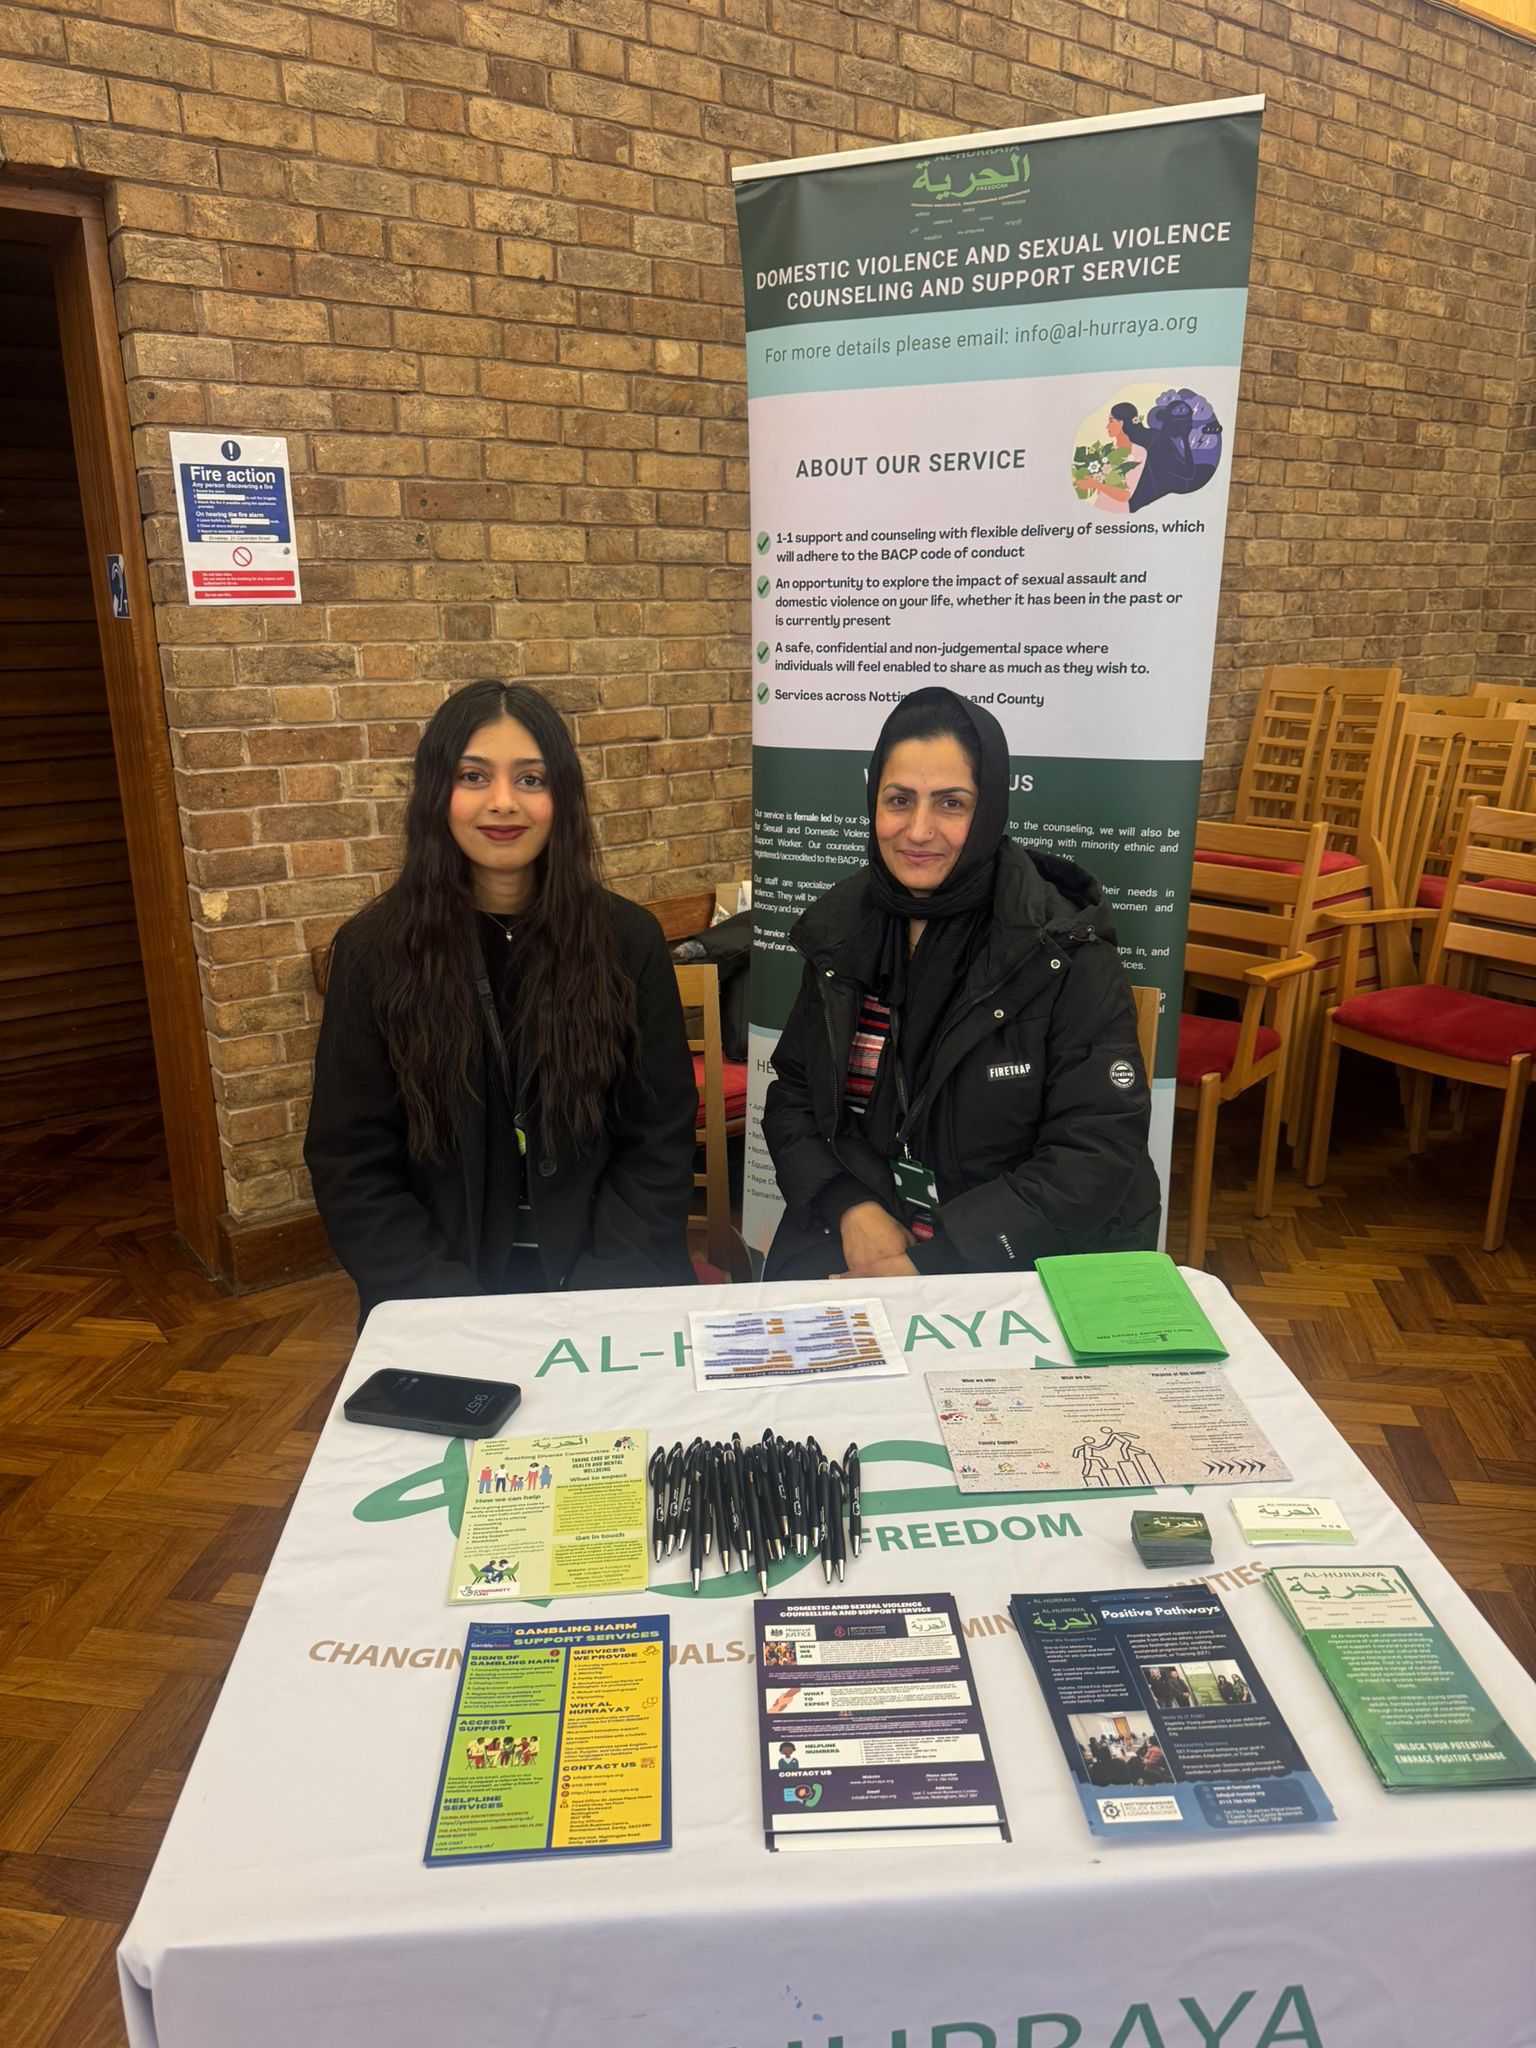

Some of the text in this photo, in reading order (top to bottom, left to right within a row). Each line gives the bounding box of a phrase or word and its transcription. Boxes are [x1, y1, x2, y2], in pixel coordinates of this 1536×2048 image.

[756, 221, 1231, 290] DOMESTIC VIOLENCE AND SEXUAL VIOLENCE
[787, 254, 1181, 310] COUNSELING AND SUPPORT SERVICE
[765, 315, 1198, 364] For more details please email: info@al-hurraya.org
[796, 449, 1026, 478] ABOUT OUR SERVICE
[190, 466, 276, 483] Fire action
[776, 520, 1205, 545] 1-1 support and counseling with flexible delivery of sessions, which
[776, 545, 1025, 562] will adhere to the BACP code of conduct
[776, 571, 1147, 591] An opportunity to explore the impact of sexual assault and
[775, 592, 1183, 609] domestic violence on your life, whether it has been in the past or
[775, 615, 891, 628] is currently present
[775, 641, 1109, 656] A safe, confidential and non-judgemental space where
[775, 660, 1150, 676] individuals will feel enabled to share as much as they wish to.
[775, 689, 1044, 707] Services across and County
[1009, 820, 1181, 838] to the counseling, we will also be
[1057, 837, 1179, 853] with minority ethnic and
[1127, 887, 1175, 898] needs in
[1112, 902, 1174, 913] women and
[989, 1063, 1031, 1078] FIRETRAP
[780, 1610, 838, 1618] COUNSELLING
[858, 1608, 896, 1616] SUPPORT
[898, 1606, 931, 1614] SERVICE
[787, 1604, 830, 1612] DOMESTIC
[850, 1602, 881, 1610] SEXUAL
[882, 1601, 922, 1609] VIOLENCE
[1101, 1604, 1221, 1619] Positive Pathways
[514, 1622, 637, 1636] GAMBLING HARM
[513, 1630, 660, 1646] SUPPORT SERVICES
[1394, 1739, 1495, 1751] UNLOCK YOUR POTENTIAL
[1395, 1752, 1507, 1764] EMBRACE POSITIVE CHANGE
[563, 1763, 618, 1772] CONTACT
[779, 1769, 819, 1778] CONTACT
